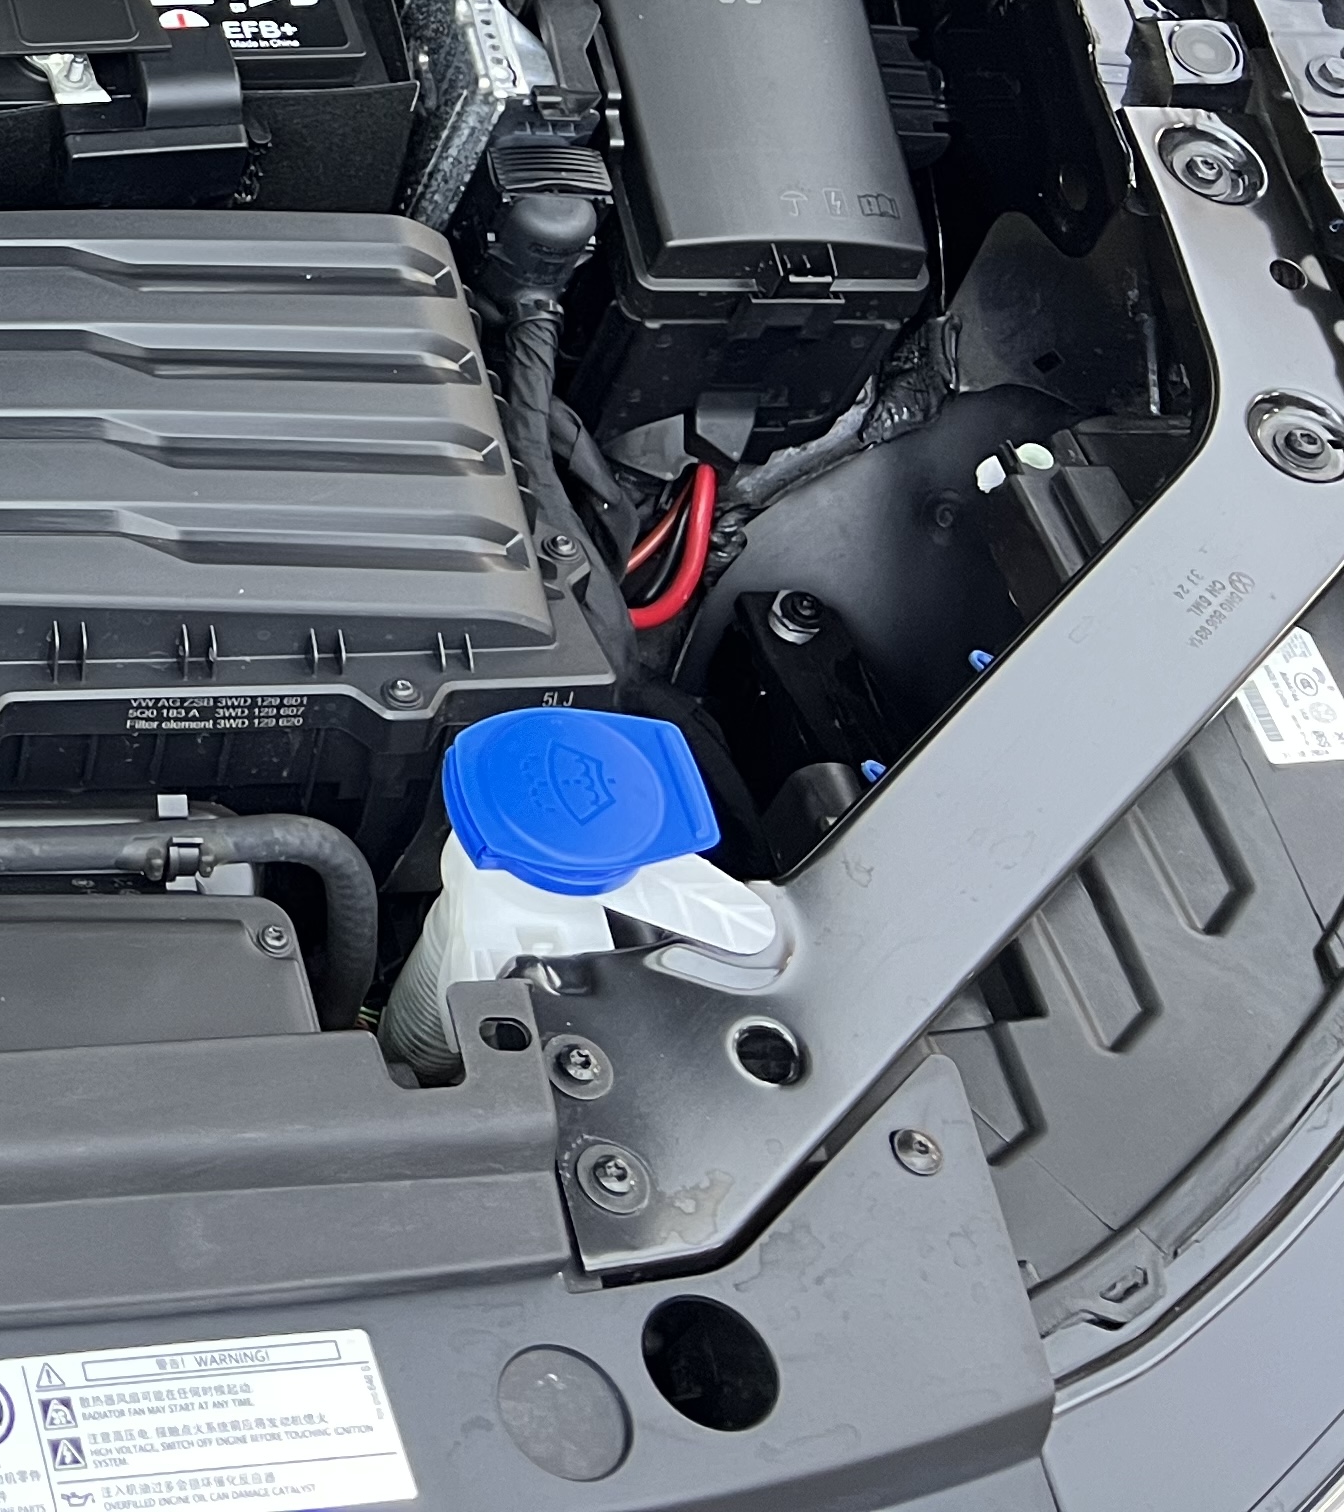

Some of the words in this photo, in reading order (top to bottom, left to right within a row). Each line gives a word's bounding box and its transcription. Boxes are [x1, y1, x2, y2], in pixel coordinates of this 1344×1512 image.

[222, 20, 298, 39] EFB+
[230, 39, 259, 48] Made
[259, 39, 270, 48] in
[269, 39, 300, 48] China
[130, 698, 155, 707] VW
[157, 698, 181, 707] AG
[183, 698, 213, 707] ZSB
[217, 697, 251, 706] 3WD
[283, 696, 308, 706] 601
[188, 708, 200, 718] A
[214, 707, 248, 717] 3WD
[280, 706, 304, 716] 607
[126, 719, 159, 730] Filter
[162, 719, 213, 729] element
[216, 718, 249, 728] 3WD
[194, 1350, 270, 1368] WARNING!
[81, 1406, 126, 1421] RADIATOR
[128, 1406, 146, 1417] FAN
[147, 1404, 167, 1415] MAY
[168, 1401, 195, 1414] START
[197, 1400, 209, 1411] AT
[212, 1398, 229, 1409] ANY
[90, 1446, 112, 1457] HIGH
[161, 1439, 194, 1451] SWITCH
[197, 1437, 213, 1448] OFF
[216, 1434, 247, 1446] ENGINE
[250, 1431, 283, 1443] BEFORE
[284, 1427, 331, 1440] TOUCHING
[334, 1425, 374, 1436] IGNITION
[104, 1497, 156, 1511] OVERFILLED
[158, 1495, 190, 1507] ENGINE
[193, 1493, 207, 1503] OIL
[210, 1490, 230, 1502] CAN
[231, 1486, 270, 1499] DAMAGE
[272, 1483, 316, 1496] CATALYST
